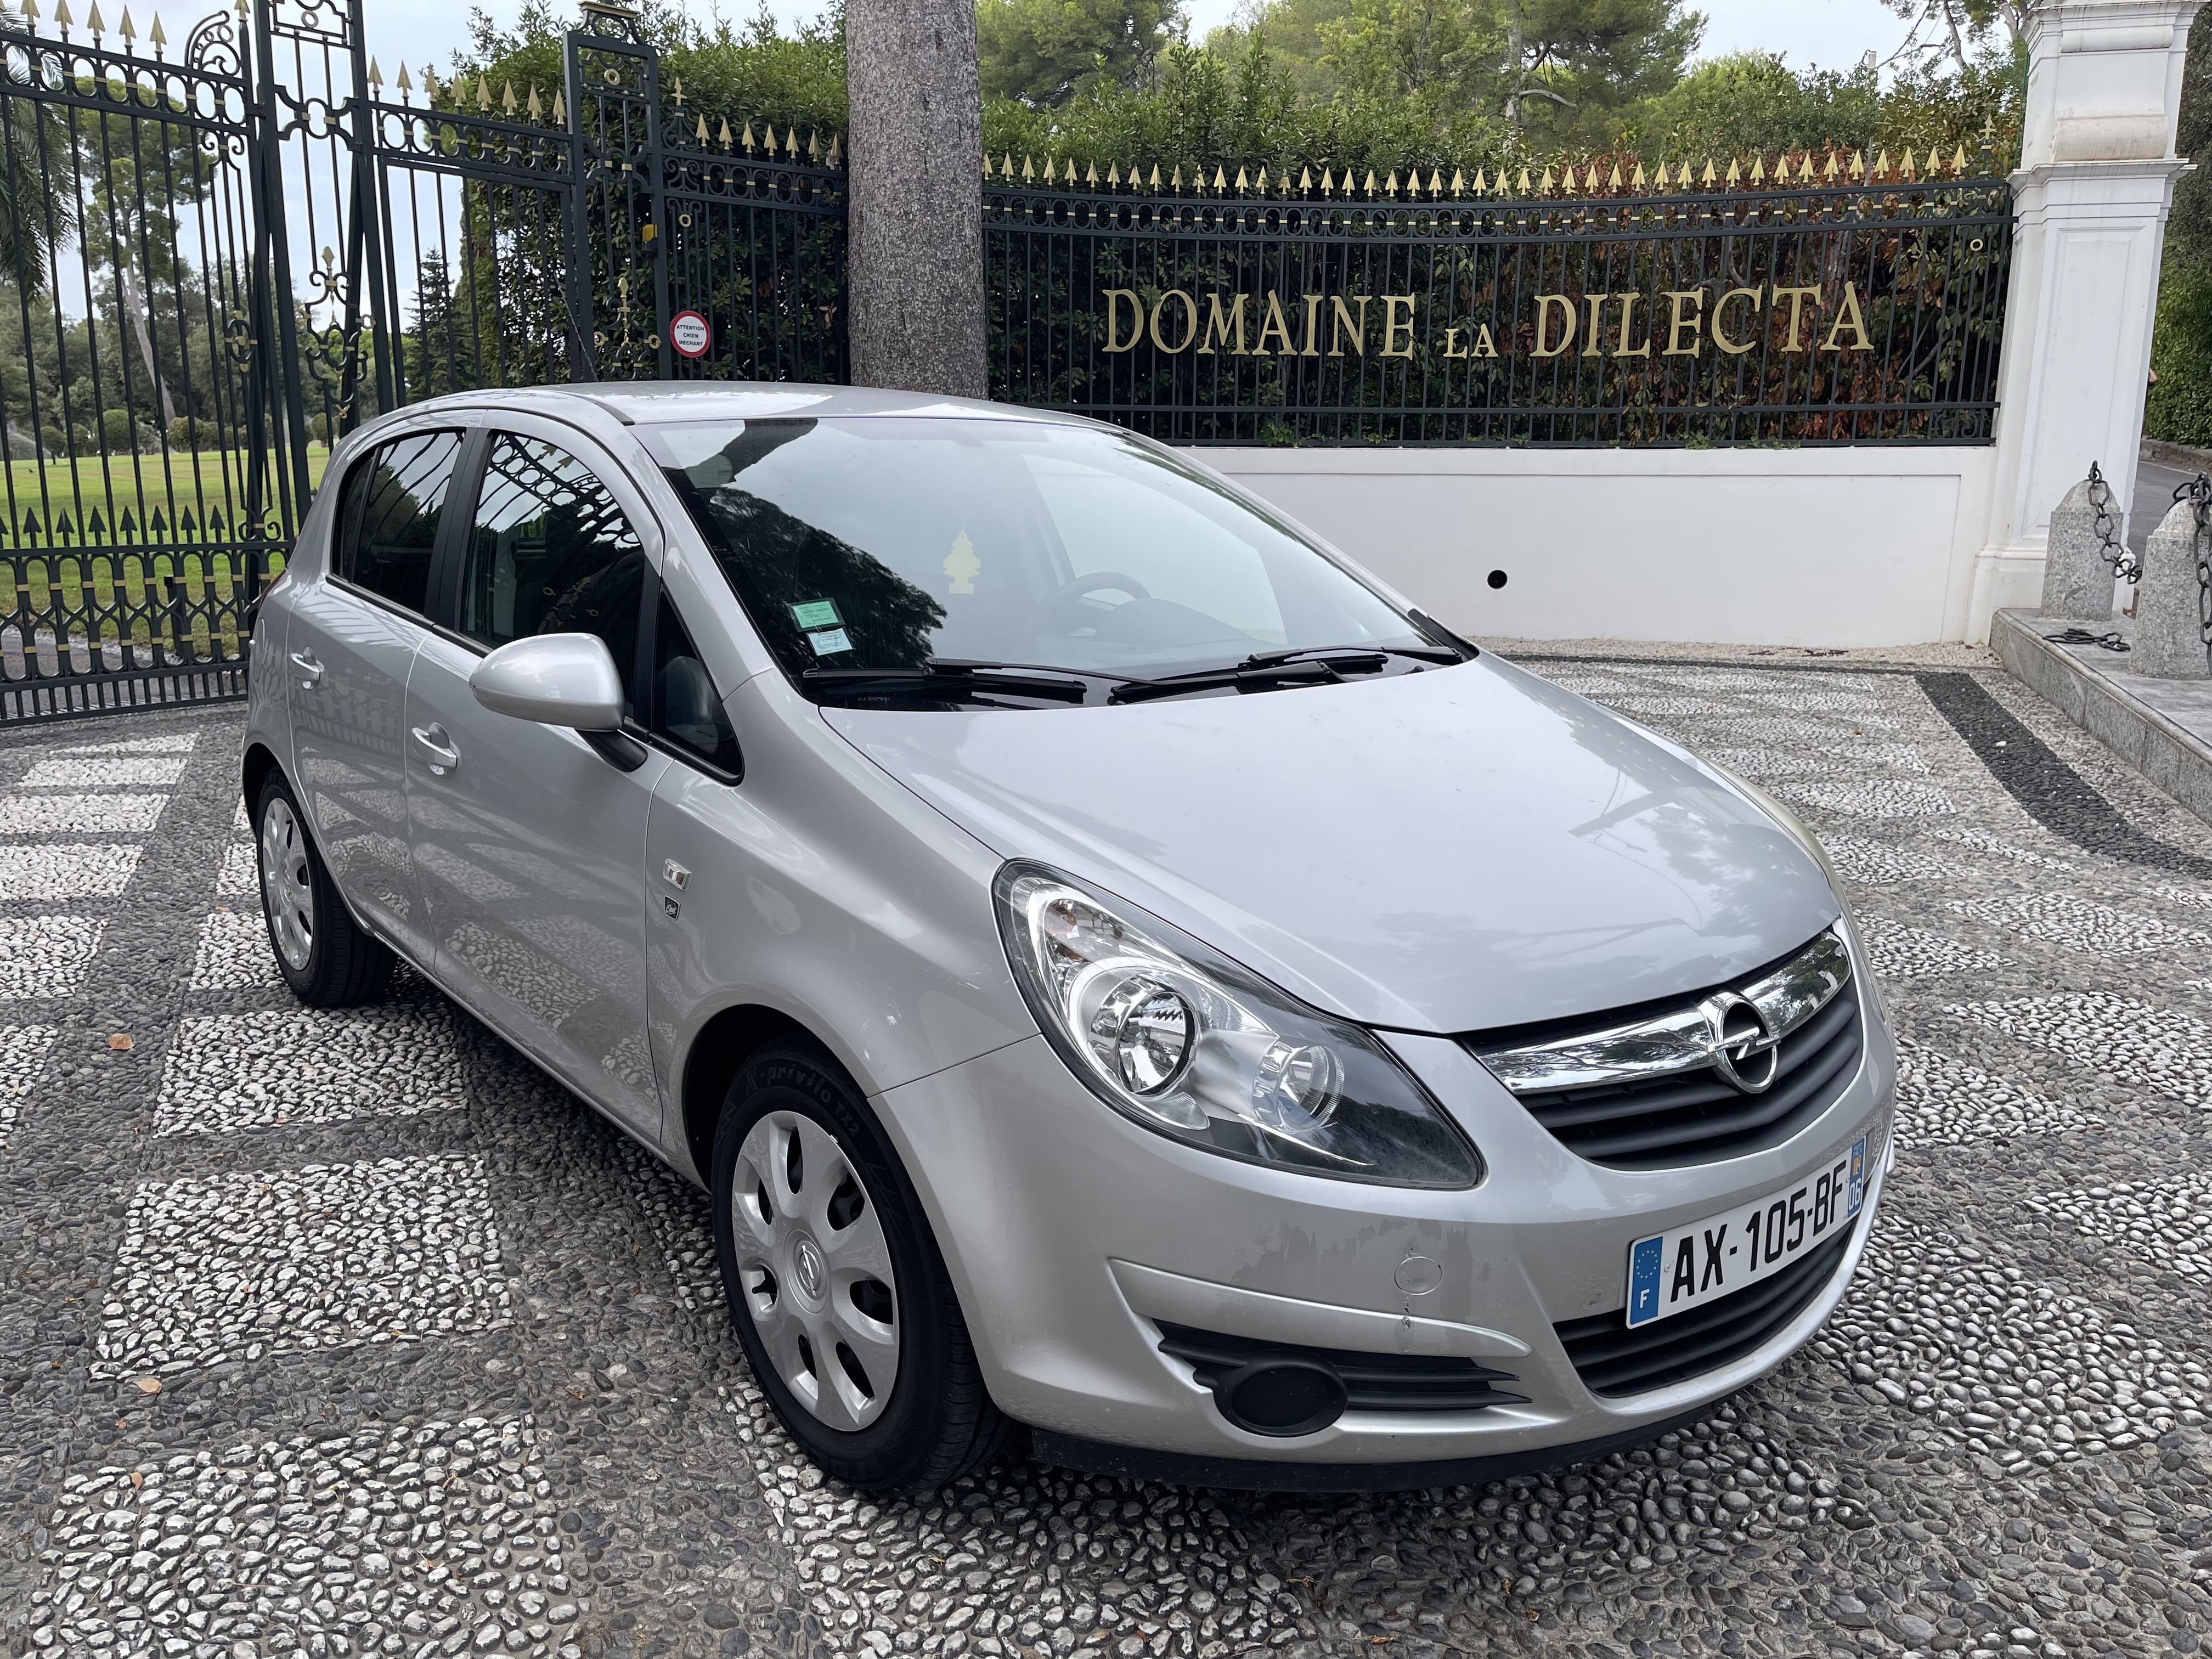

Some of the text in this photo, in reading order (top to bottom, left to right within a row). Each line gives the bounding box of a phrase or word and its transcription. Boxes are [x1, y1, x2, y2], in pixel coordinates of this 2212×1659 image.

[1102, 280, 1875, 360] DOMAINE LA DILECTA
[1848, 1177, 1861, 1210] 06
[1670, 1159, 1847, 1303] AX-105-BF
[1639, 1288, 1650, 1308] F
